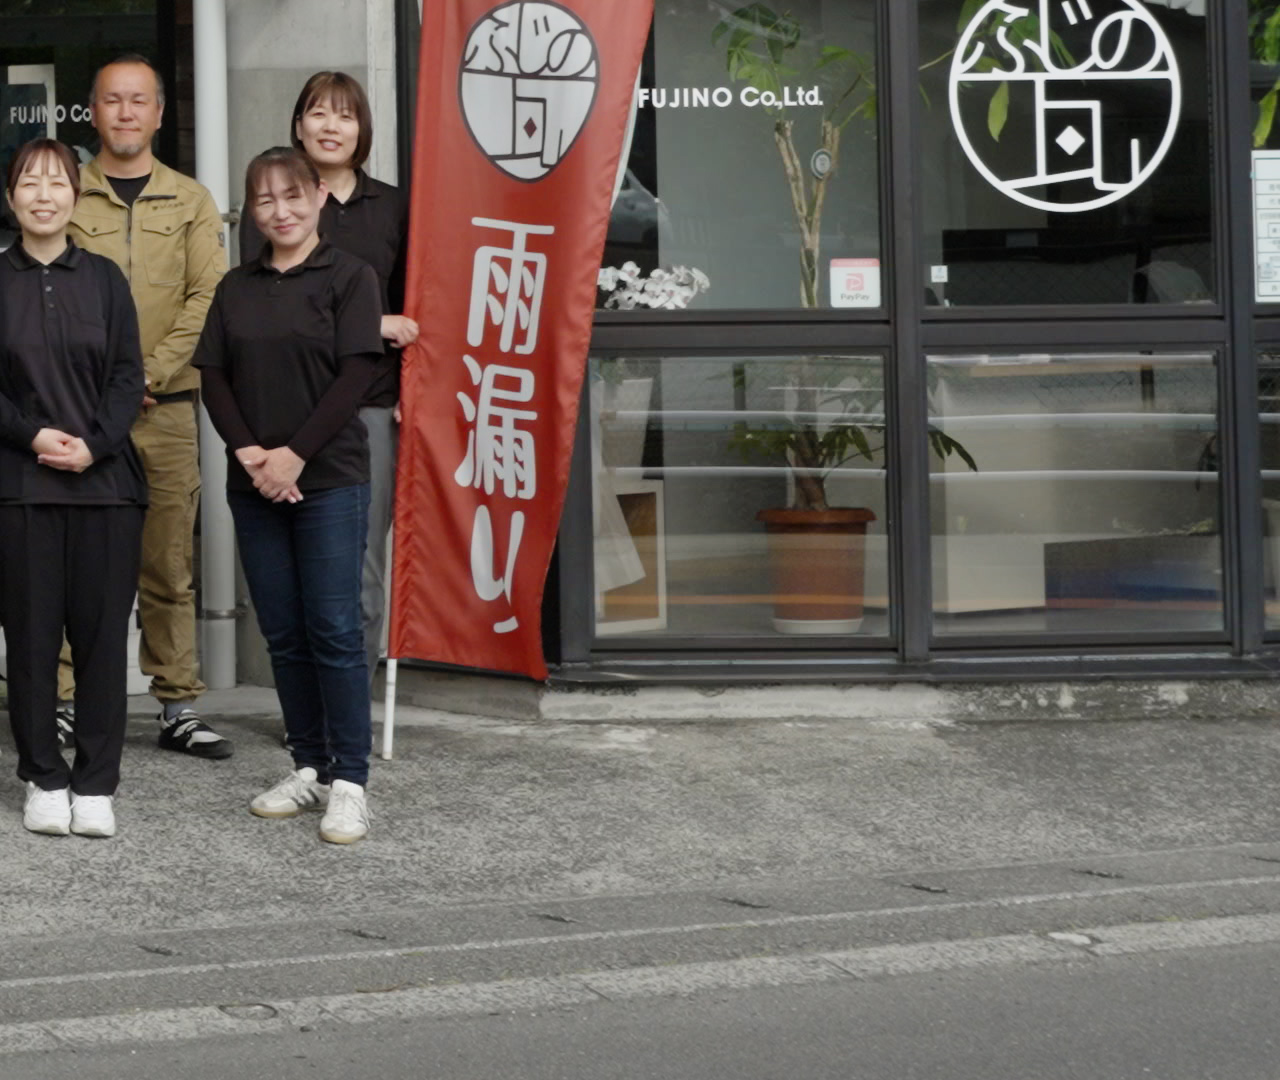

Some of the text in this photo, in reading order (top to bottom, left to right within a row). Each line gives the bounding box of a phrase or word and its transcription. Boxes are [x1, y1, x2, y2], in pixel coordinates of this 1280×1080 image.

[638, 86, 733, 109] FUJINO
[454, 216, 555, 634] 雨漏り
